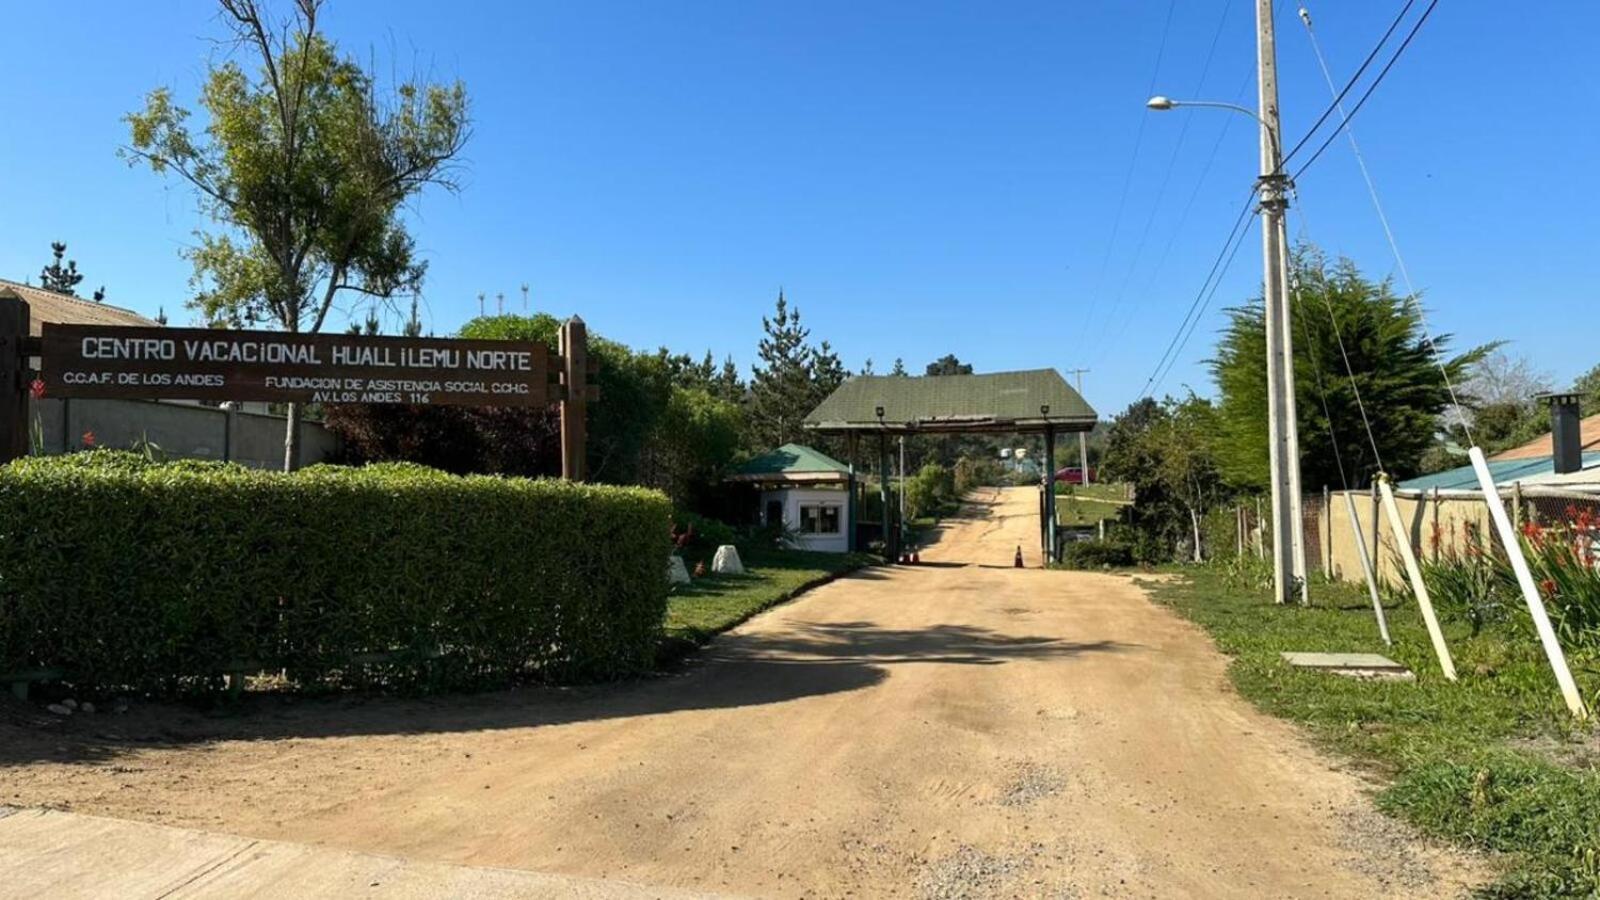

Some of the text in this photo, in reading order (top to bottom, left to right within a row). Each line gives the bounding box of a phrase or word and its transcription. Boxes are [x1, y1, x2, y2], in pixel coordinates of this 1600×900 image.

[81, 337, 176, 360] CENTRO
[466, 350, 532, 371] NORTE
[118, 372, 139, 385] DE
[143, 373, 171, 385] LOS
[175, 375, 225, 387] ANDES
[265, 376, 341, 389] FUNDACION
[344, 379, 363, 390] DE
[367, 379, 441, 392] ASISTENCIA
[444, 381, 489, 393] SOCIAL
[361, 392, 402, 403] ANDES
[410, 393, 430, 404] 116
